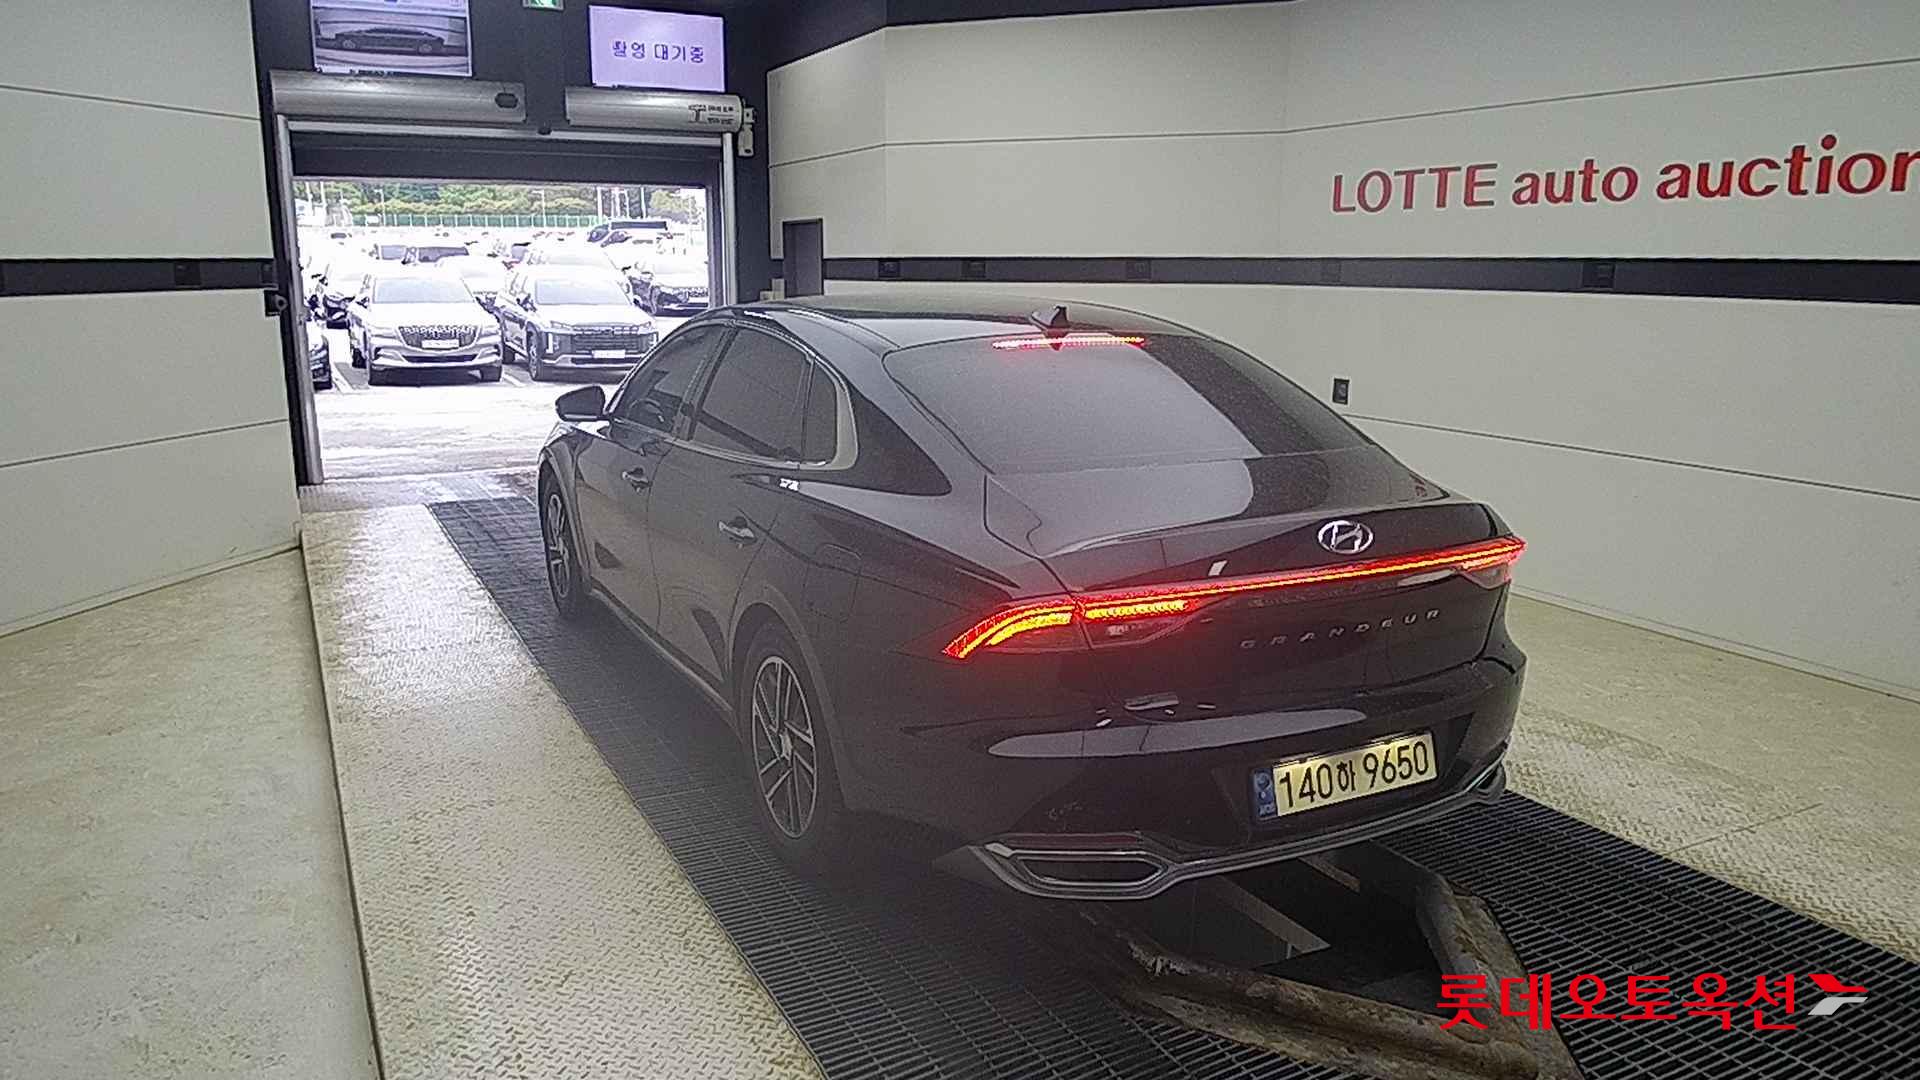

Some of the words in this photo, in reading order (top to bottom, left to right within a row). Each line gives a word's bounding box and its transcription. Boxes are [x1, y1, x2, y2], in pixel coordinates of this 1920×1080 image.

[653, 43, 704, 64] 대기중
[1331, 163, 1498, 214] LOTTE
[1511, 158, 1639, 206] auto
[1239, 608, 1440, 649] GRANDEUR
[1279, 759, 1357, 808] 140하
[1362, 740, 1429, 789] 9650
